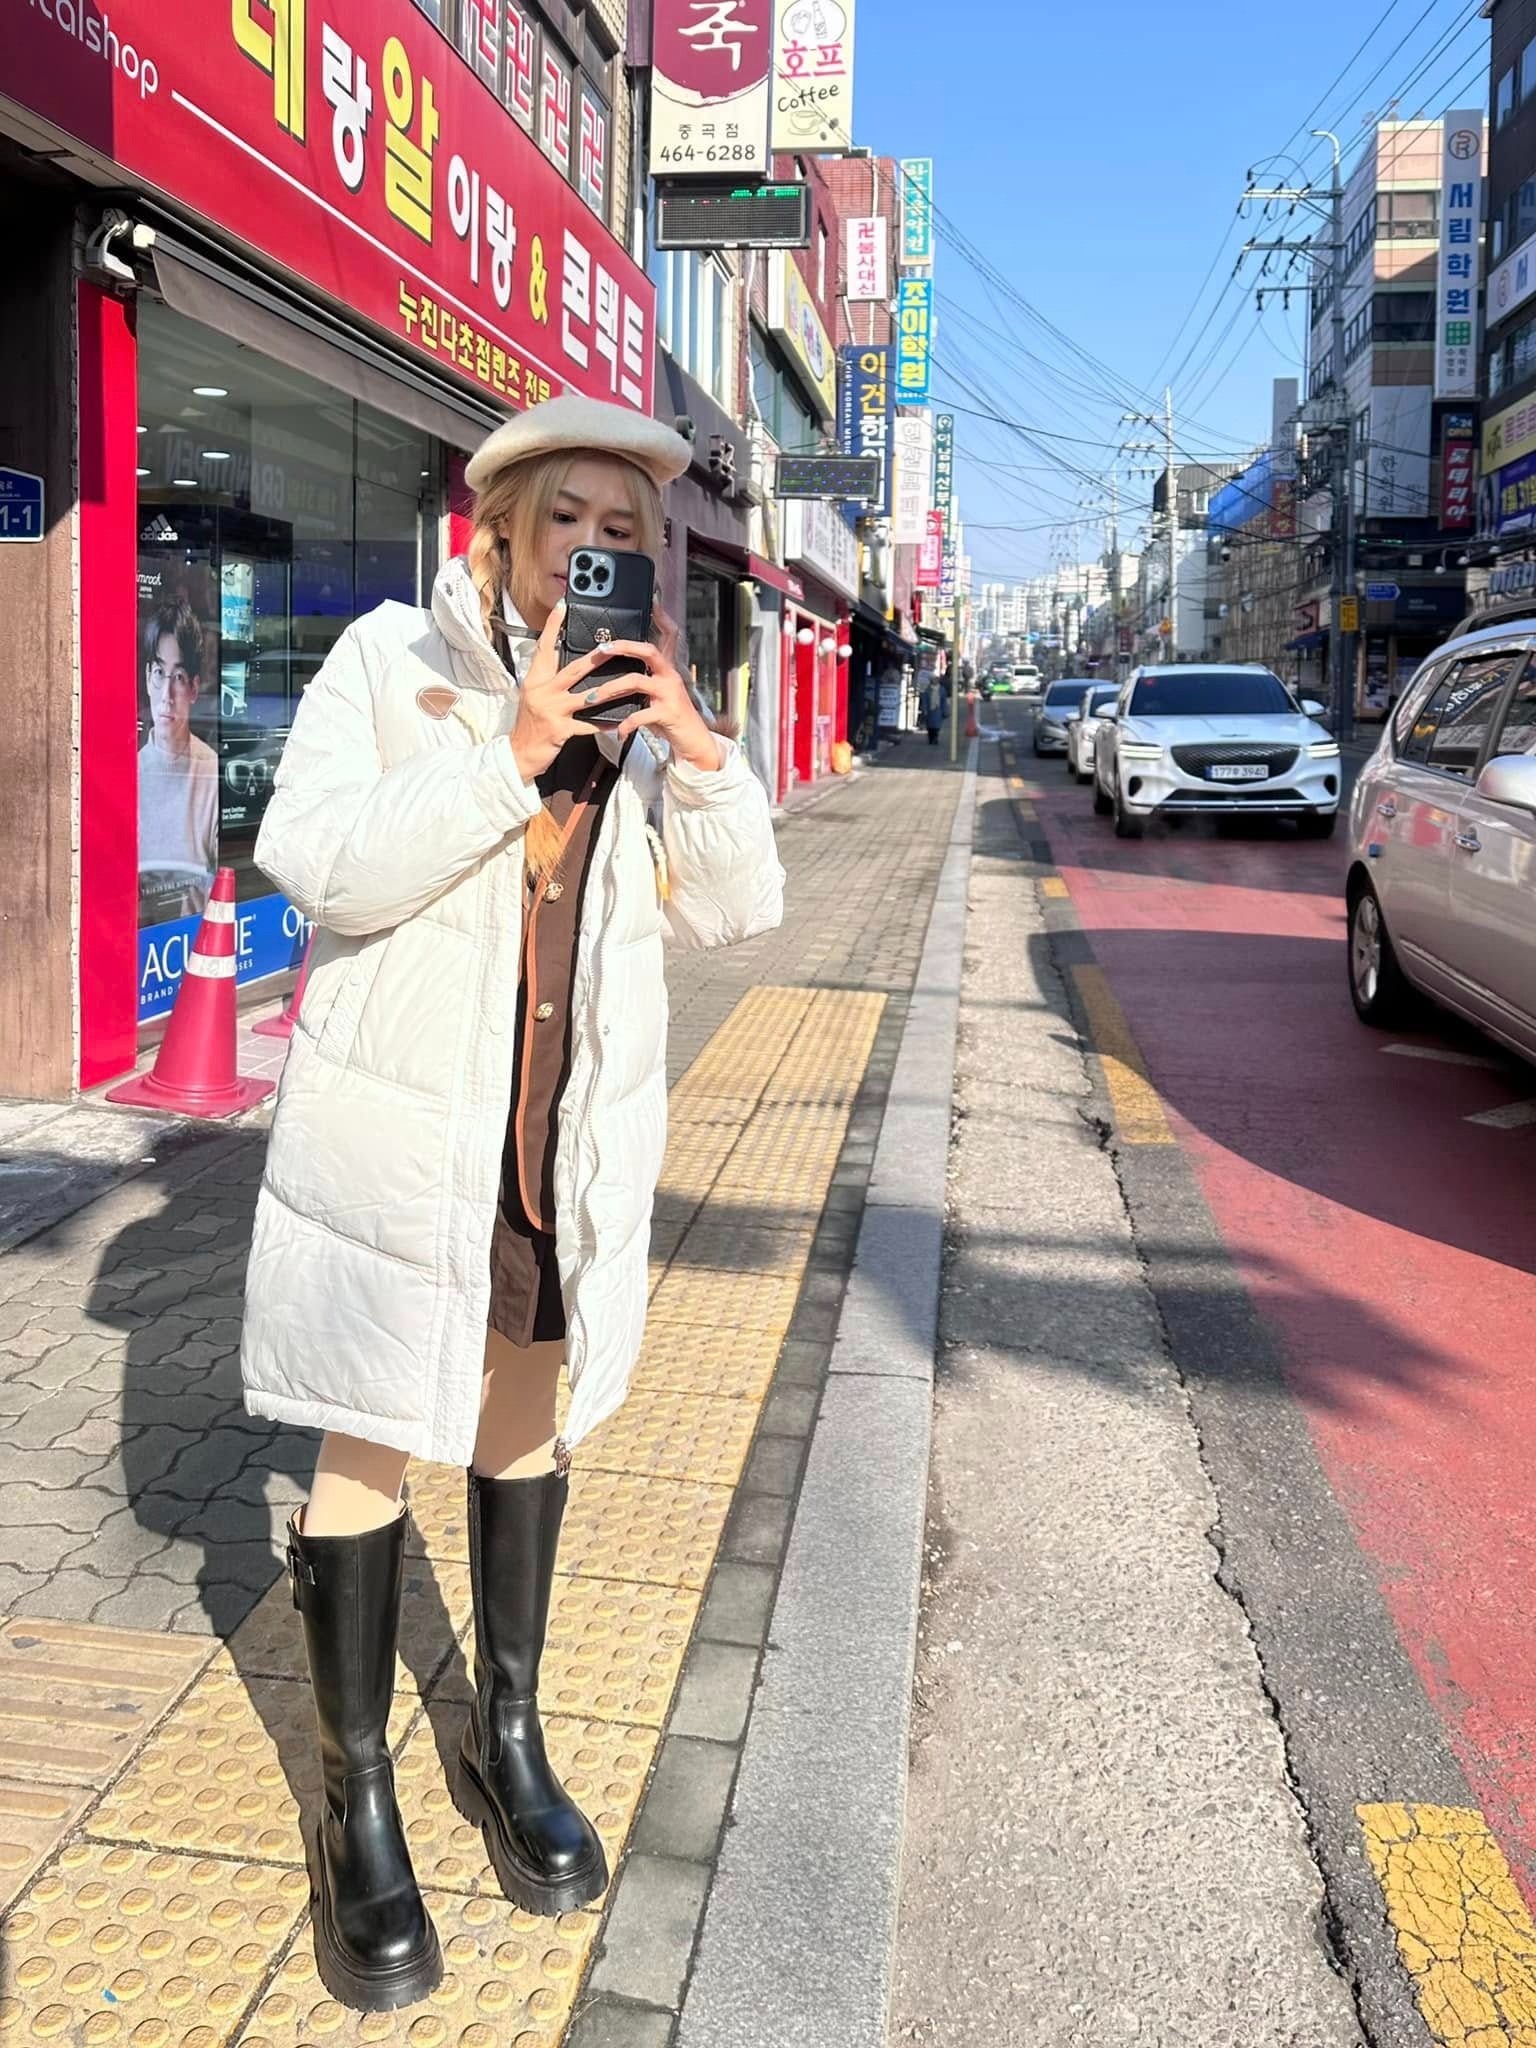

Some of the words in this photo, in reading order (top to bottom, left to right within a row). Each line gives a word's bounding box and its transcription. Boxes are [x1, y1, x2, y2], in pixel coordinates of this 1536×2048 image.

[677, 2, 758, 71] 죽
[778, 40, 847, 79] 호프
[777, 83, 840, 113] Coffee
[659, 144, 756, 162] 464-6288
[1445, 181, 1473, 315] 서림학원
[399, 279, 521, 401] 누진다초점렌즈
[530, 234, 549, 326] &
[561, 228, 644, 410] 콘택트
[903, 281, 928, 389] 조이학원
[140, 531, 179, 541] adidas
[140, 986, 174, 1005] BRAND
